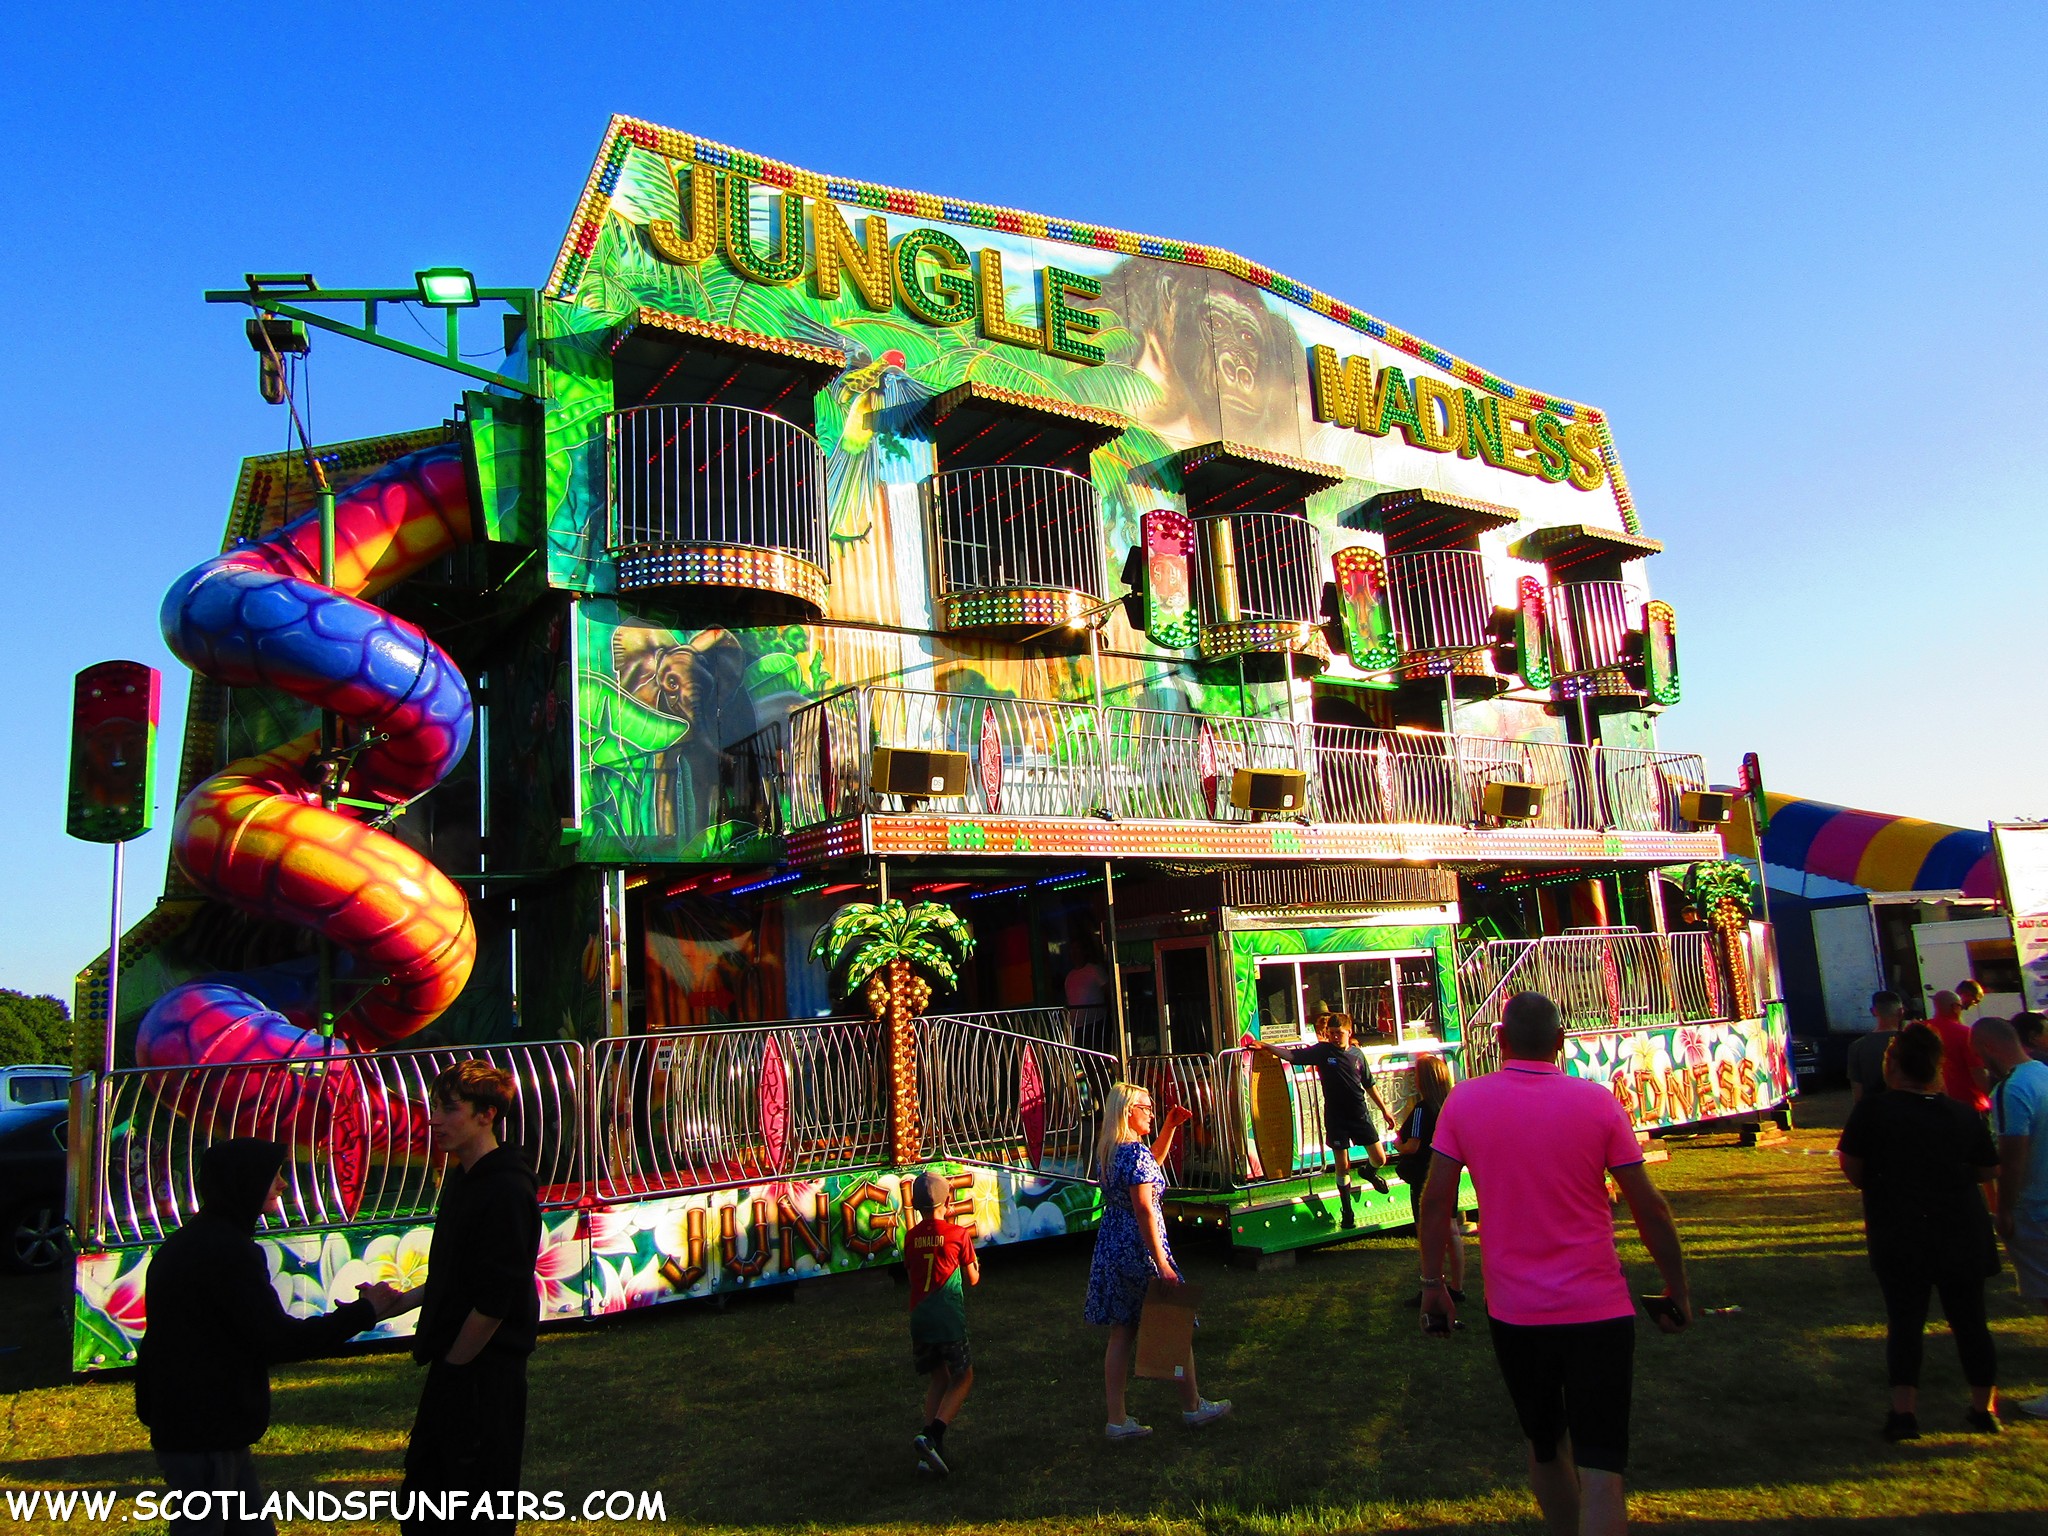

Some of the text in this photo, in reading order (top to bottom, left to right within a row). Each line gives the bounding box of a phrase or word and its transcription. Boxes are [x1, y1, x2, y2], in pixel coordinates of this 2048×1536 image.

[649, 163, 1106, 365] JUNGLE
[1311, 343, 1606, 491] MADNESS
[2017, 920, 2034, 928] SALT
[764, 1057, 787, 1148] JUNGLE
[1613, 1059, 1756, 1126] ADNESS
[914, 1235, 945, 1249] RONALDO
[923, 1252, 935, 1292] 7
